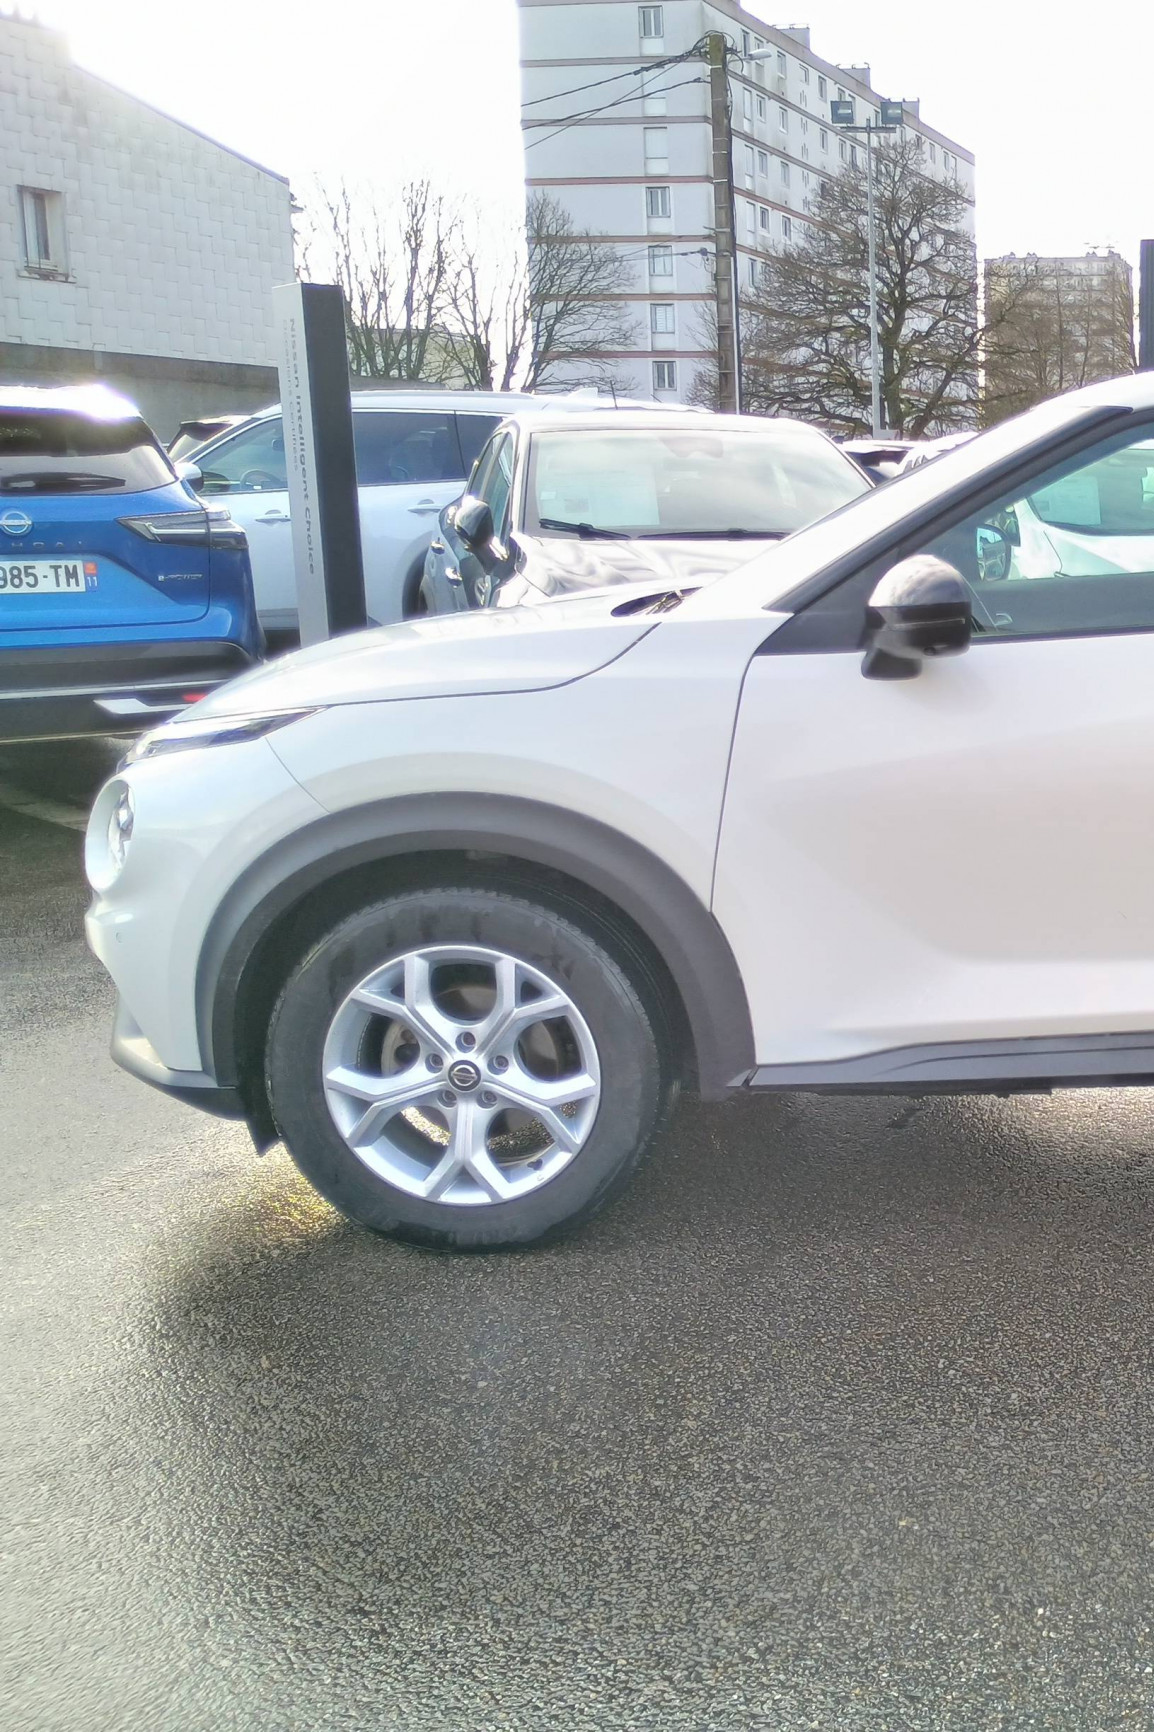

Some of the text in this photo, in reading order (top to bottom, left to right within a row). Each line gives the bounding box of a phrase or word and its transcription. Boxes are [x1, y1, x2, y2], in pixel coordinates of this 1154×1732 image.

[290, 318, 316, 576] Nissan Intelligent Choice
